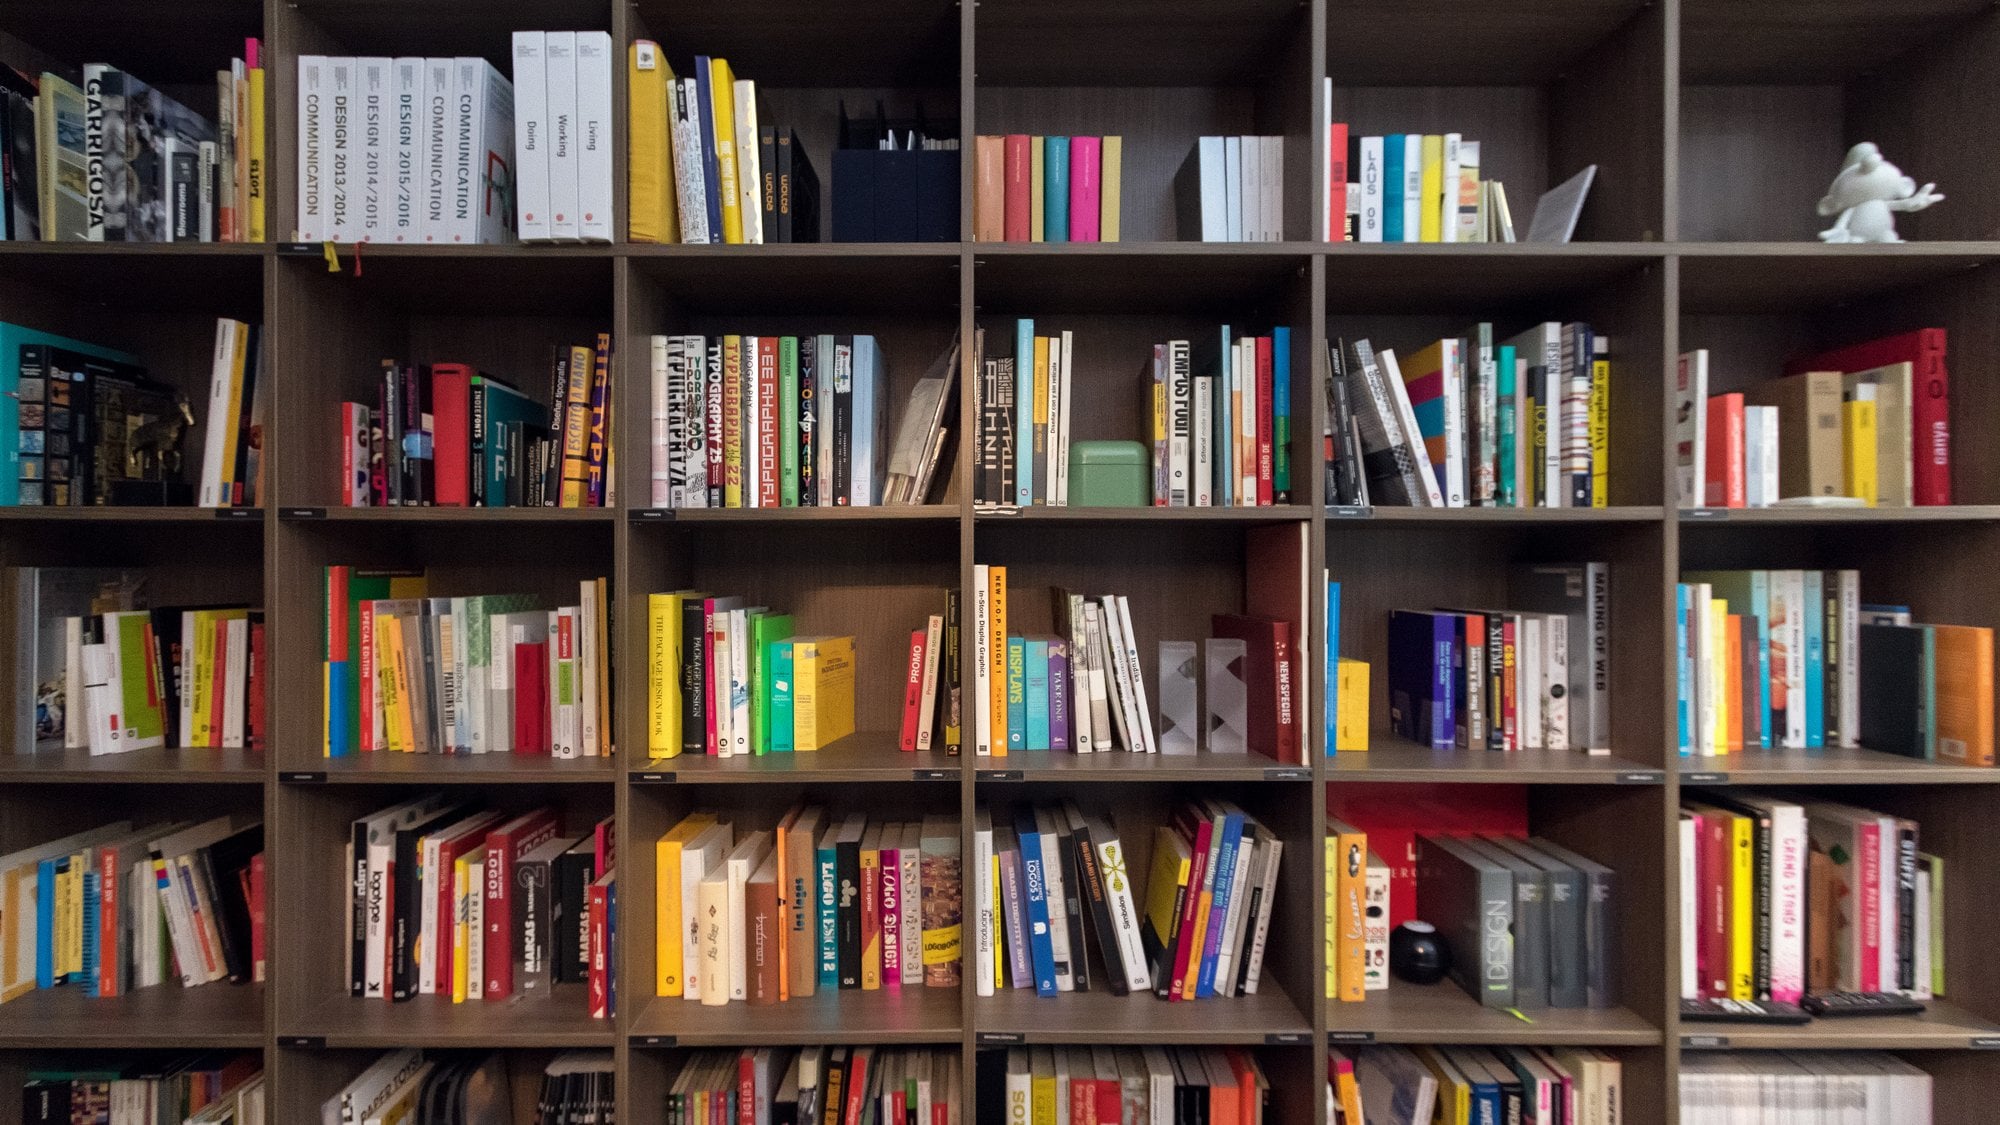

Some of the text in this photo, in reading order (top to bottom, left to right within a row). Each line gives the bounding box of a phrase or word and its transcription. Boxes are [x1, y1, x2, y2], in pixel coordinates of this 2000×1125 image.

[86, 78, 103, 229] GARRIGOSA
[306, 94, 318, 216] COMMUNICATION
[456, 94, 471, 219] COMMUNICATION
[526, 121, 536, 151] Doing
[556, 115, 567, 158] Working
[586, 120, 598, 151] Living
[250, 159, 259, 199] Lofts
[334, 96, 347, 226] DESIGN 2013/2014
[365, 95, 379, 229] DESIGN 2014/2015
[397, 94, 412, 227] DESIGN 2015/2016
[430, 96, 445, 221] COMMUNICATION
[177, 183, 186, 237] Showrooms
[1367, 151, 1377, 229] LAUS 09
[746, 344, 754, 409] TYPOGRAPHY
[474, 390, 482, 439] INDIEFONTS
[552, 401, 563, 431] Diseñar
[568, 352, 585, 451] ESCRITO A MANO
[588, 333, 610, 483] BIG TYPE
[708, 345, 722, 464] TYPOGRAPHY 25
[725, 343, 739, 487] TYPOGRAPHY 22
[473, 442, 483, 450] 3
[1596, 426, 1604, 451] DNA
[1262, 443, 1270, 480] DISEÑO DE
[362, 611, 370, 642] SPECIAL
[706, 614, 714, 633] PACK
[978, 620, 986, 646] Display
[1595, 572, 1606, 691] MAKING OF WEB
[910, 645, 922, 684] PROMO
[927, 655, 935, 673] made
[979, 647, 987, 678] Graphics
[1491, 627, 1503, 673] XHTML
[1504, 645, 1515, 666] CSS
[455, 661, 464, 703] Packaging
[655, 675, 663, 708] DESIGN
[692, 637, 701, 718] PACKAGE DESIGN
[925, 674, 933, 696] Promo
[1010, 645, 1022, 704] DISPLAYS
[1055, 671, 1063, 696] TAKE
[655, 711, 663, 735] BOOK
[1470, 694, 1478, 710] Mac
[865, 858, 871, 867] 04
[1027, 860, 1038, 892] LOGOS
[1205, 847, 1220, 885] Branding
[1783, 838, 1797, 879] GRAND
[369, 871, 383, 923] logotype
[488, 849, 498, 932] LOGOS 2
[793, 878, 806, 931] los logos
[822, 862, 837, 906] LOGO
[1784, 884, 1797, 924] STAND
[579, 911, 590, 963] MARCAS
[882, 865, 898, 969] LOGO DESIGN
[980, 909, 990, 953] Introducing
[1008, 866, 1025, 973] BRAND IDENTITY NOW!
[525, 921, 535, 973] MARCAS
[1488, 900, 1508, 980] DESIGN
[823, 961, 836, 971] 2
[743, 1080, 752, 1117] GUIDE
